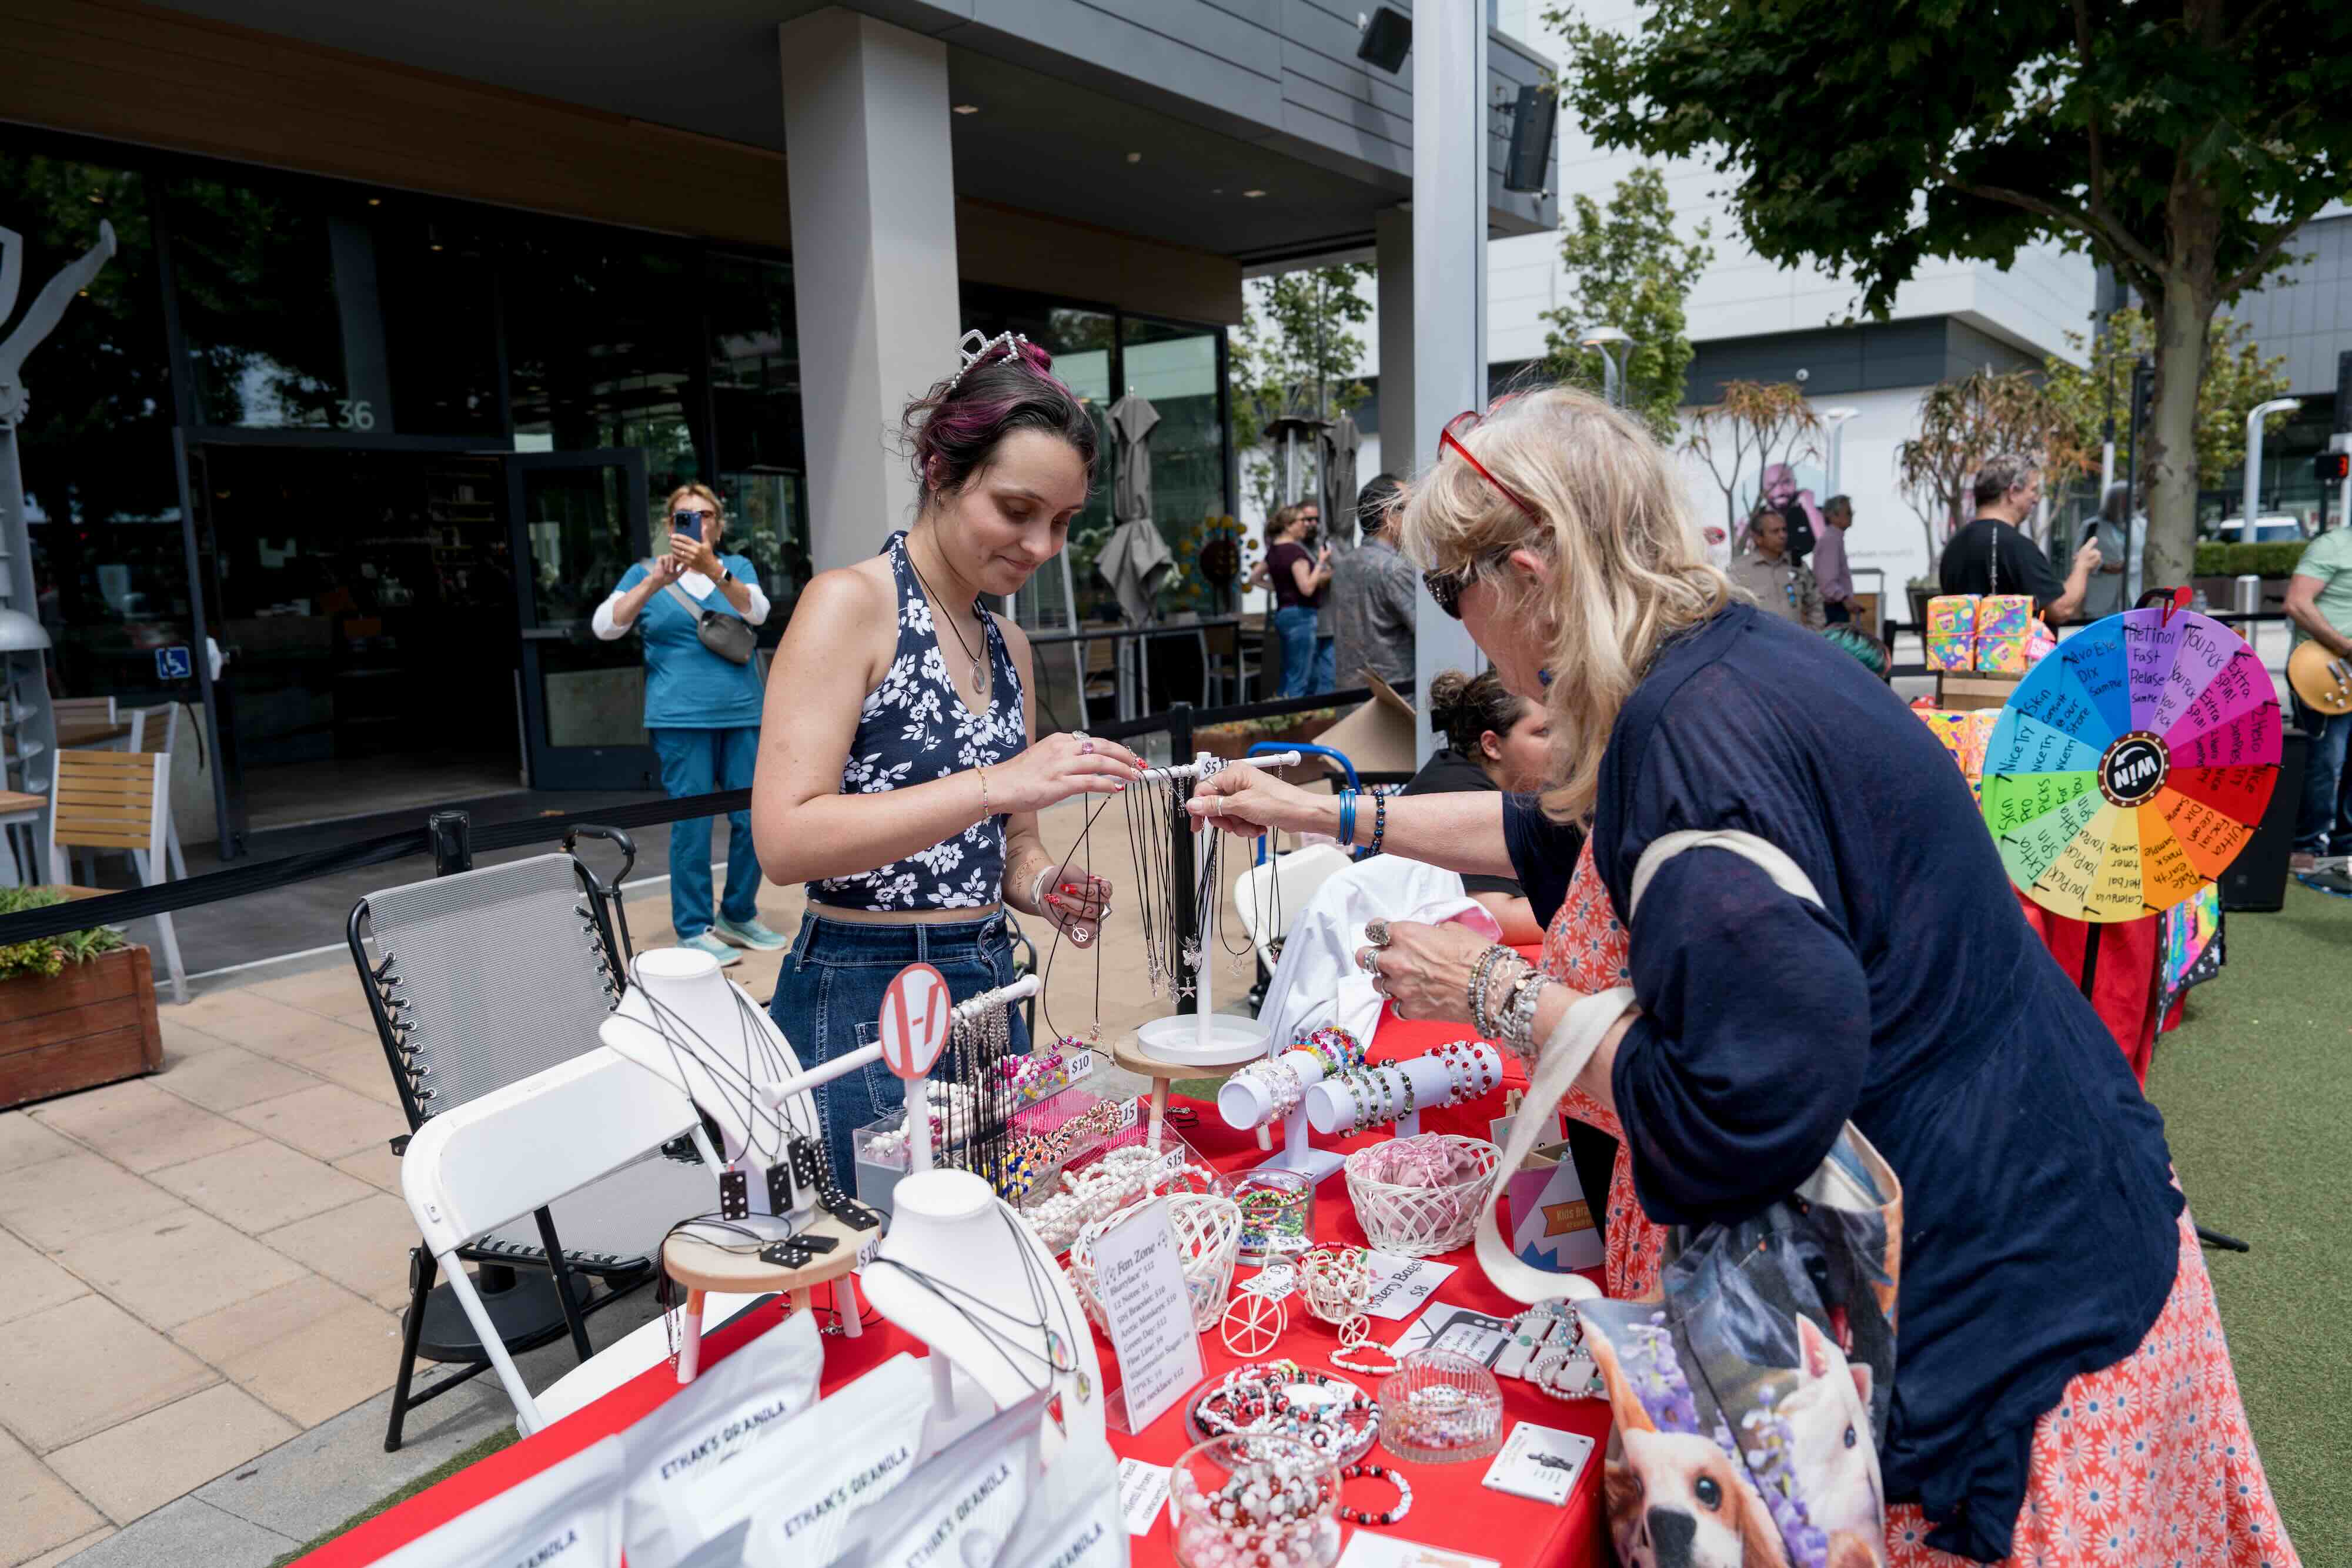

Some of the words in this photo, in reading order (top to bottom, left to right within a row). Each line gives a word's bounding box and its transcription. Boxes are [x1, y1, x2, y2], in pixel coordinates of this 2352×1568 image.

[335, 400, 375, 430] 36
[2129, 622, 2175, 645] Retinol
[1997, 745, 2024, 771] Nice
[2013, 725, 2035, 743] Try
[1204, 761, 1217, 775] $5
[2019, 837, 2046, 880] Extra
[1071, 1054, 1090, 1075] $10
[1167, 1151, 1183, 1170] $15
[860, 1239, 879, 1268] $10
[1117, 1258, 1133, 1275] Fan
[1134, 1243, 1155, 1264] Zone
[1409, 1285, 1429, 1298] $8
